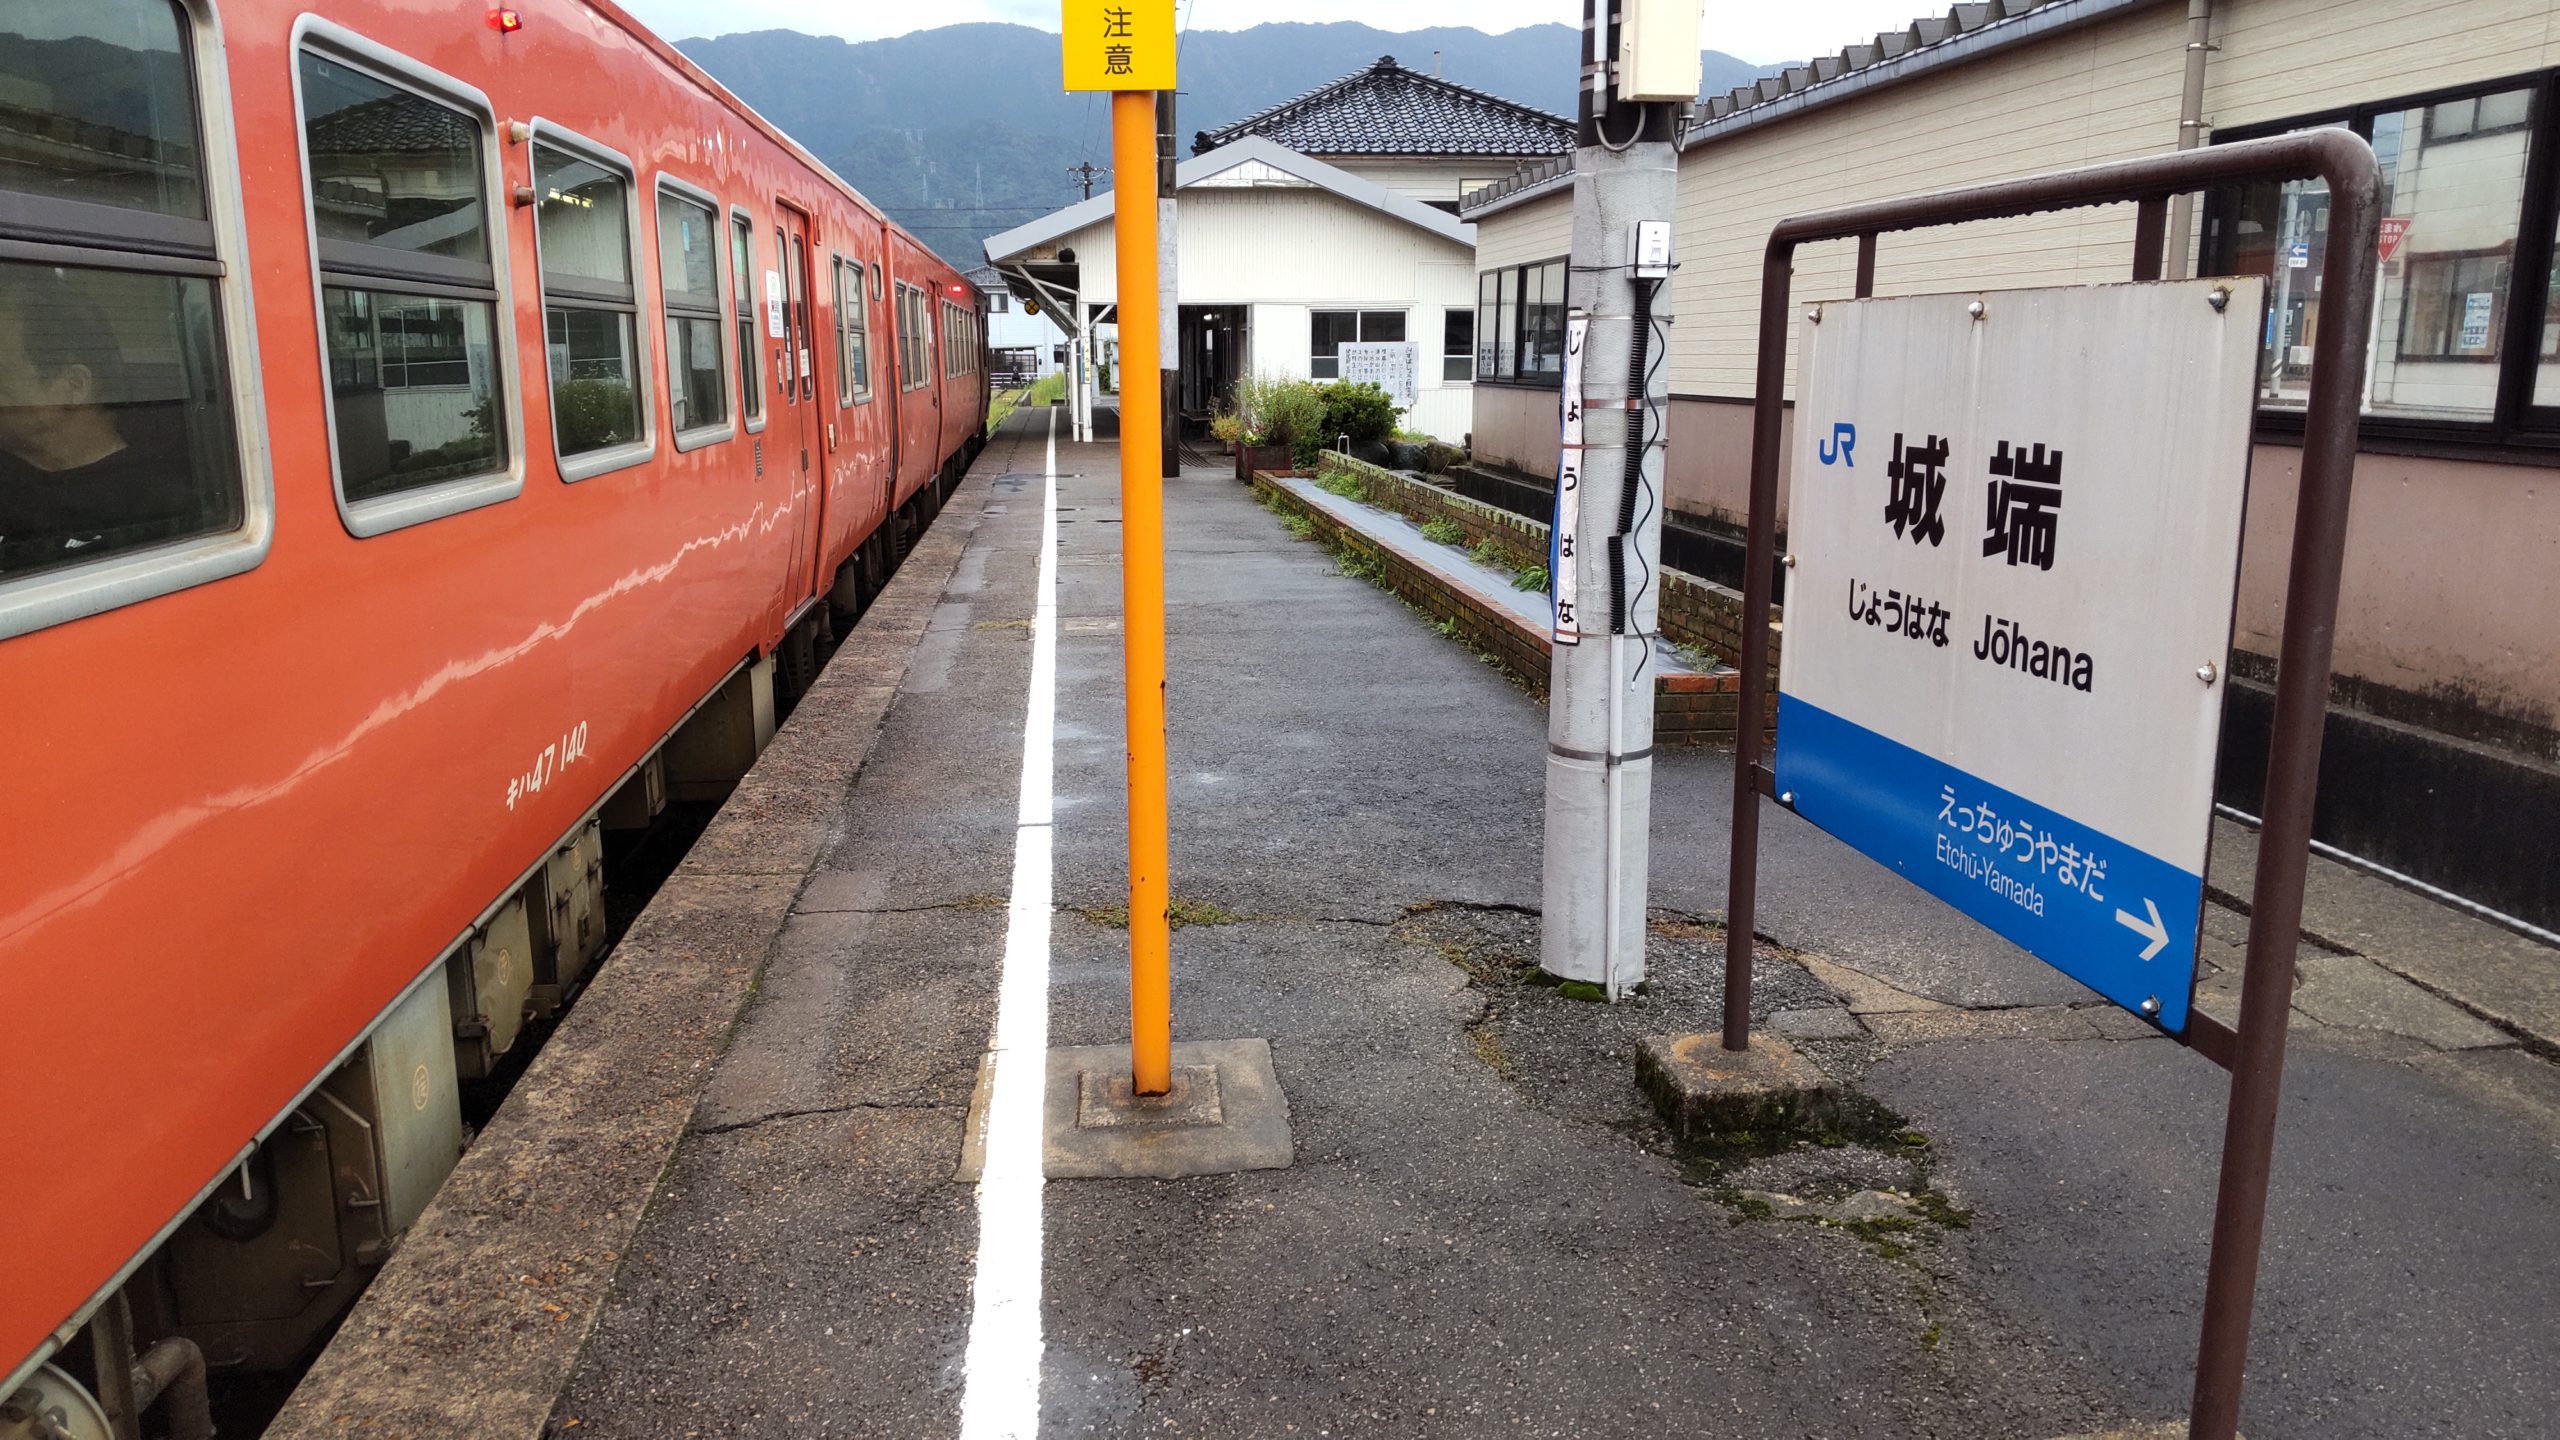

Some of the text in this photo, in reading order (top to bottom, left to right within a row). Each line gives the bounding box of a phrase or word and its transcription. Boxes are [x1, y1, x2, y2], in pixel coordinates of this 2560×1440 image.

[1103, 6, 1133, 75] 注意
[1557, 330, 1582, 624] じょうはな
[1819, 422, 1856, 467] JR
[1885, 433, 2063, 571] 城端
[1848, 578, 1951, 648] じょうはな
[1973, 614, 2093, 693] Jōhana
[560, 720, 587, 772] 140
[1936, 833, 2044, 918] Etchū-Yamada
[1938, 784, 2107, 902] えっちゅうやまだ
